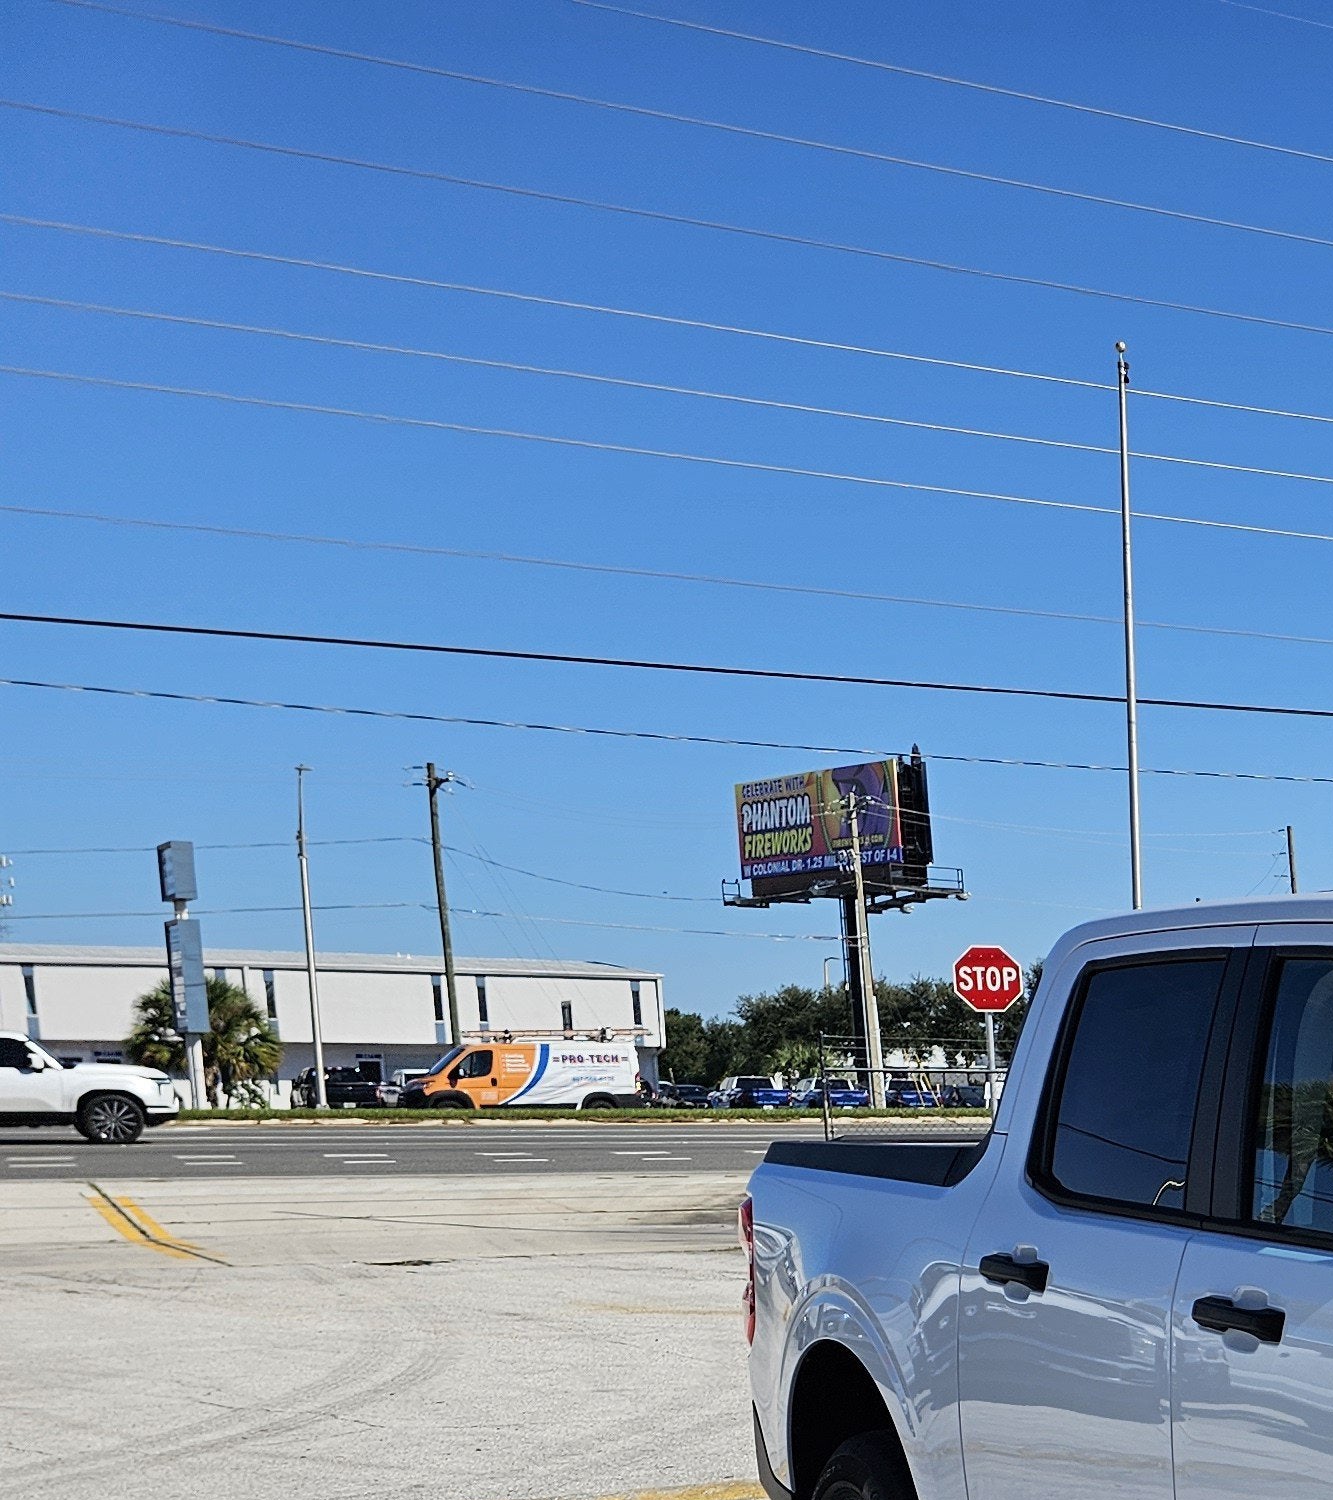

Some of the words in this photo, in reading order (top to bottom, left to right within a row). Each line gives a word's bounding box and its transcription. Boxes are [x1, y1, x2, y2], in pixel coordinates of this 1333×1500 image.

[742, 779, 783, 799] CELEBRATE
[741, 795, 811, 833] PHANTOM
[744, 826, 813, 859] FIREWORKS
[752, 860, 790, 876] COLONIAL
[873, 848, 886, 862] OF
[886, 847, 898, 861] I-4
[958, 966, 1018, 992] STOP
[561, 1054, 620, 1064] PRO-TECH
